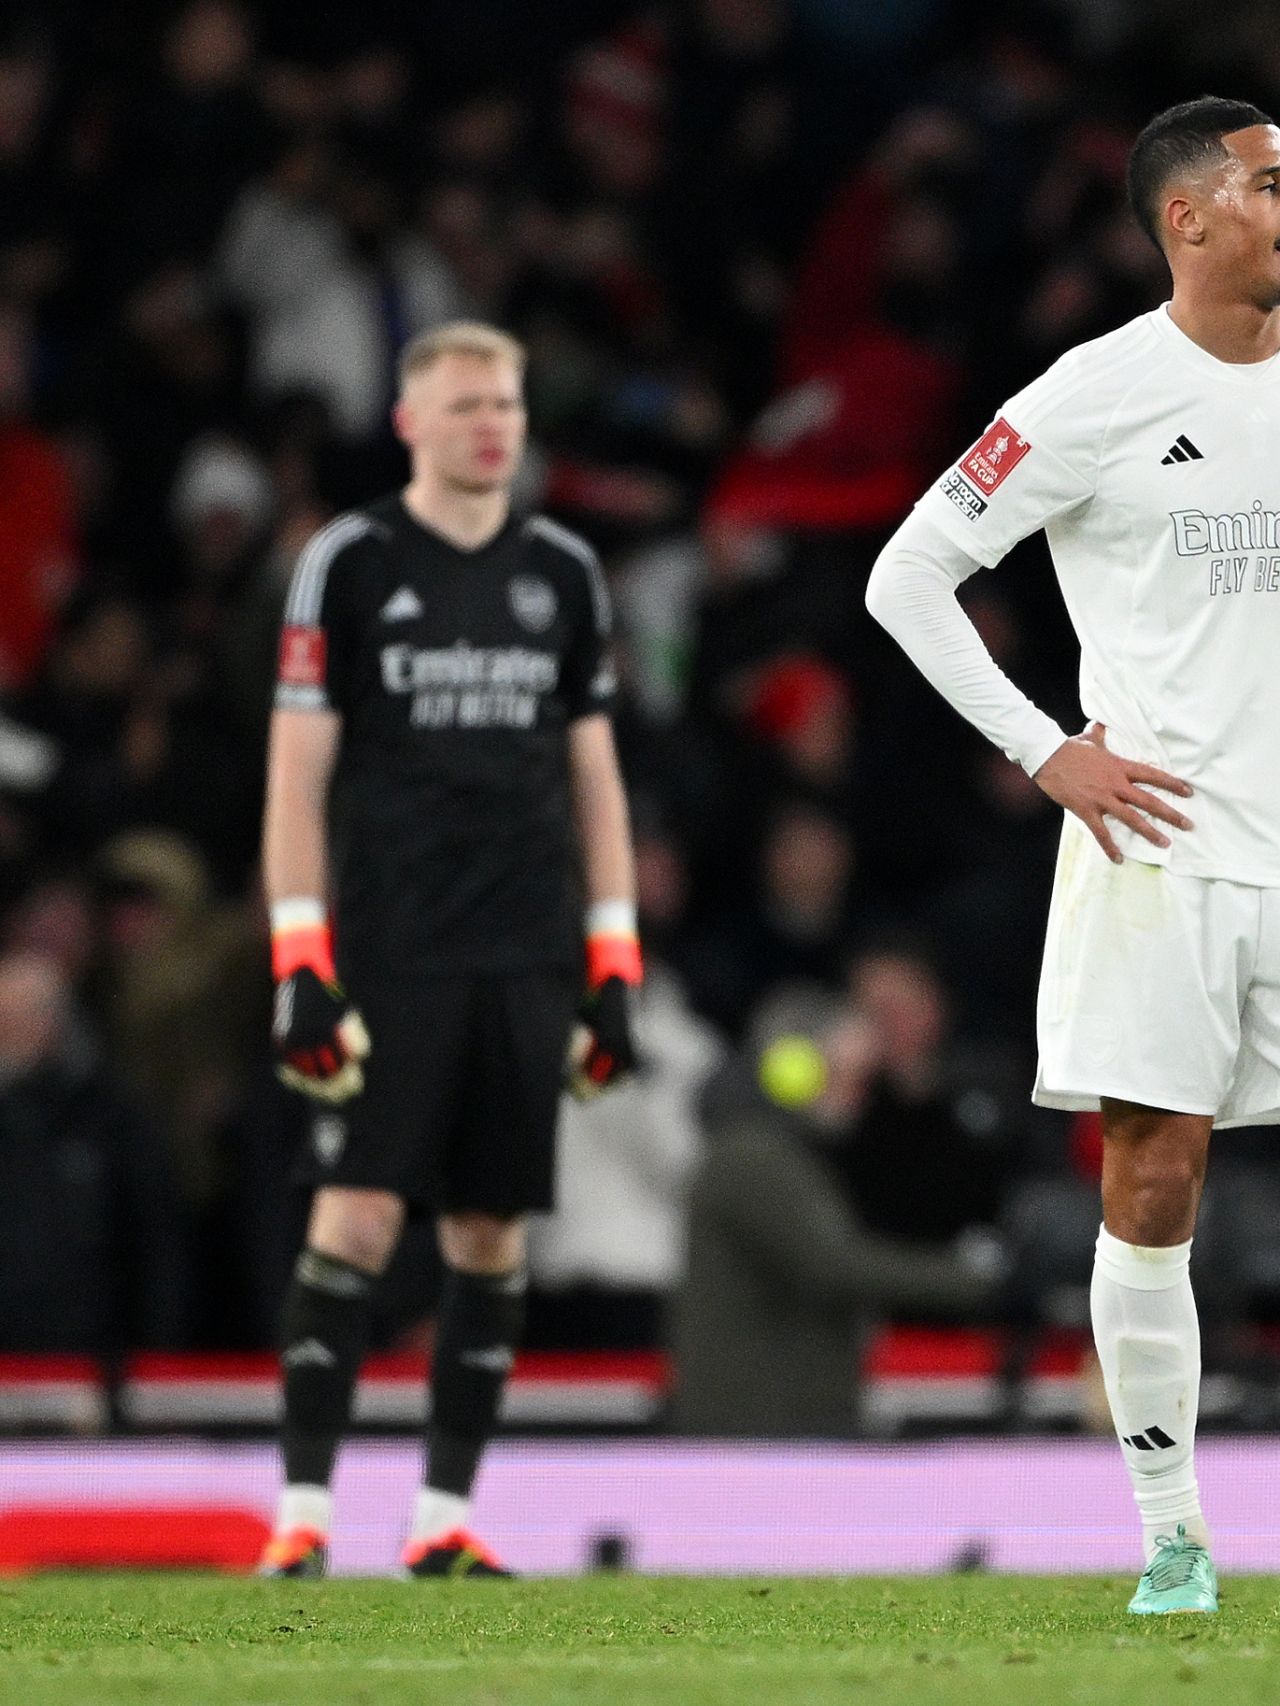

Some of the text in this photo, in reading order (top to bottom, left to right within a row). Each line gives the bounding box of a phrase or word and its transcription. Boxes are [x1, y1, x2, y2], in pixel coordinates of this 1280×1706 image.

[968, 459, 995, 485] FA CUP
[948, 490, 979, 521] racism
[955, 482, 982, 510] room
[1210, 557, 1248, 596] FLY
